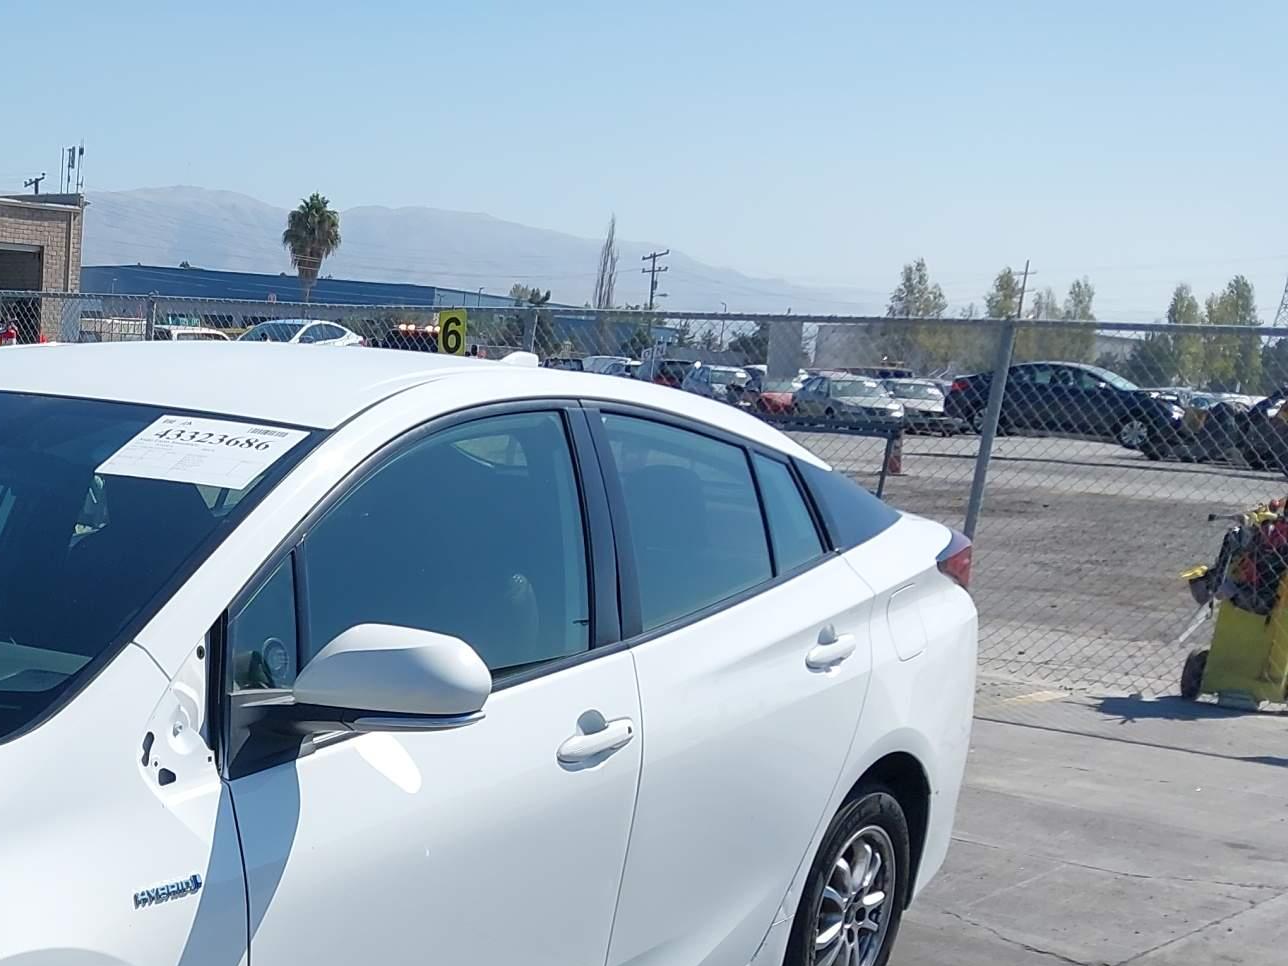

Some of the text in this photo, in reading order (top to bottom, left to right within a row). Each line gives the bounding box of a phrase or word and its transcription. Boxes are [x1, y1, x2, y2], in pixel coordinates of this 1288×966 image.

[443, 316, 461, 354] 6
[155, 428, 273, 451] 43323686
[133, 880, 192, 906] HYBRID
